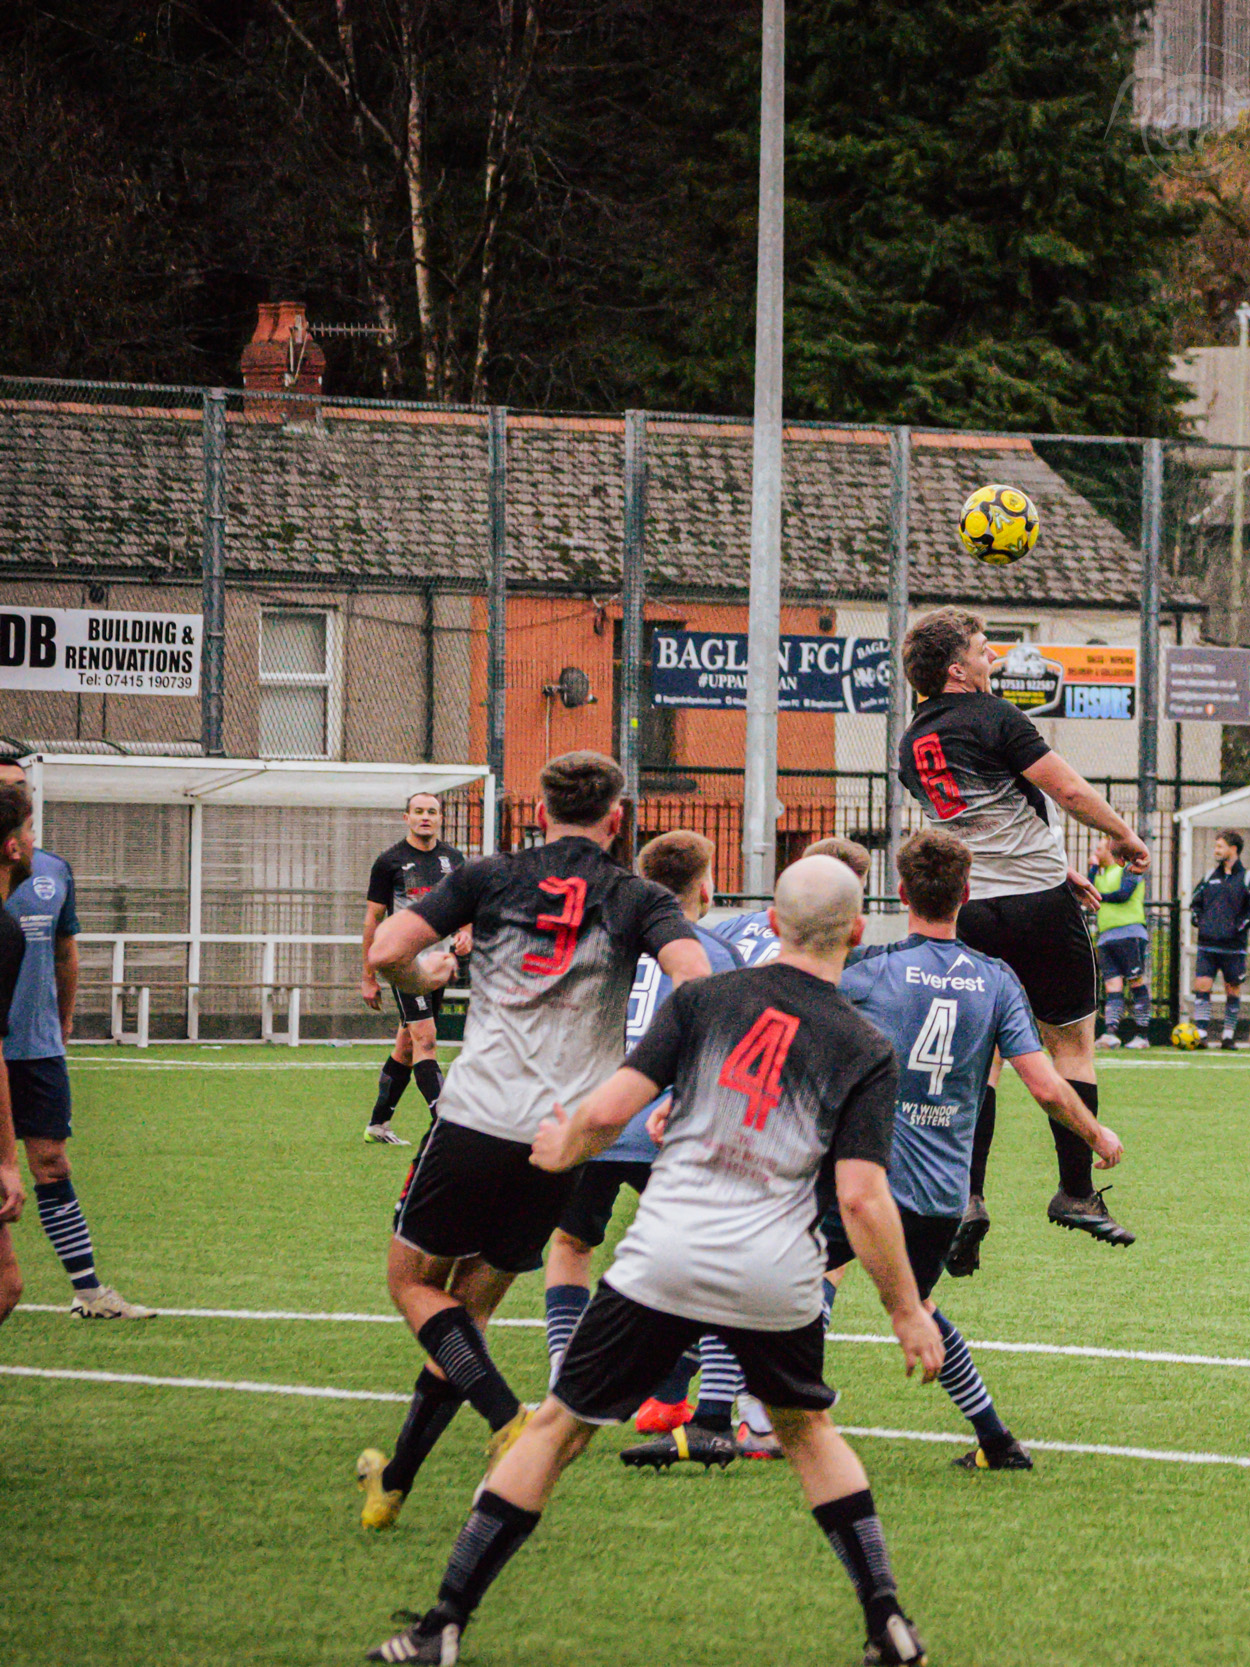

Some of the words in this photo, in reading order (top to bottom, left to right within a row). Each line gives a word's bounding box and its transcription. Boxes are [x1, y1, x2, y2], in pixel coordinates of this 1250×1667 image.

[88, 618, 177, 645] BUILDING
[182, 625, 194, 645] &
[65, 645, 193, 673] RENOVATIONS
[657, 637, 792, 673] BAGLN
[798, 642, 840, 674] FC
[78, 672, 101, 686] Tel:
[105, 674, 144, 688] 07415
[148, 675, 192, 689] 190739
[1065, 685, 1131, 719] LEISURE
[912, 732, 968, 820] 8
[521, 876, 588, 976] 3
[905, 966, 985, 993] Everest
[907, 997, 958, 1096] 4
[718, 1006, 801, 1132] 4
[902, 1101, 918, 1114] W2
[920, 1104, 960, 1116] WINDOW
[910, 1114, 950, 1127] SYSTEMS
